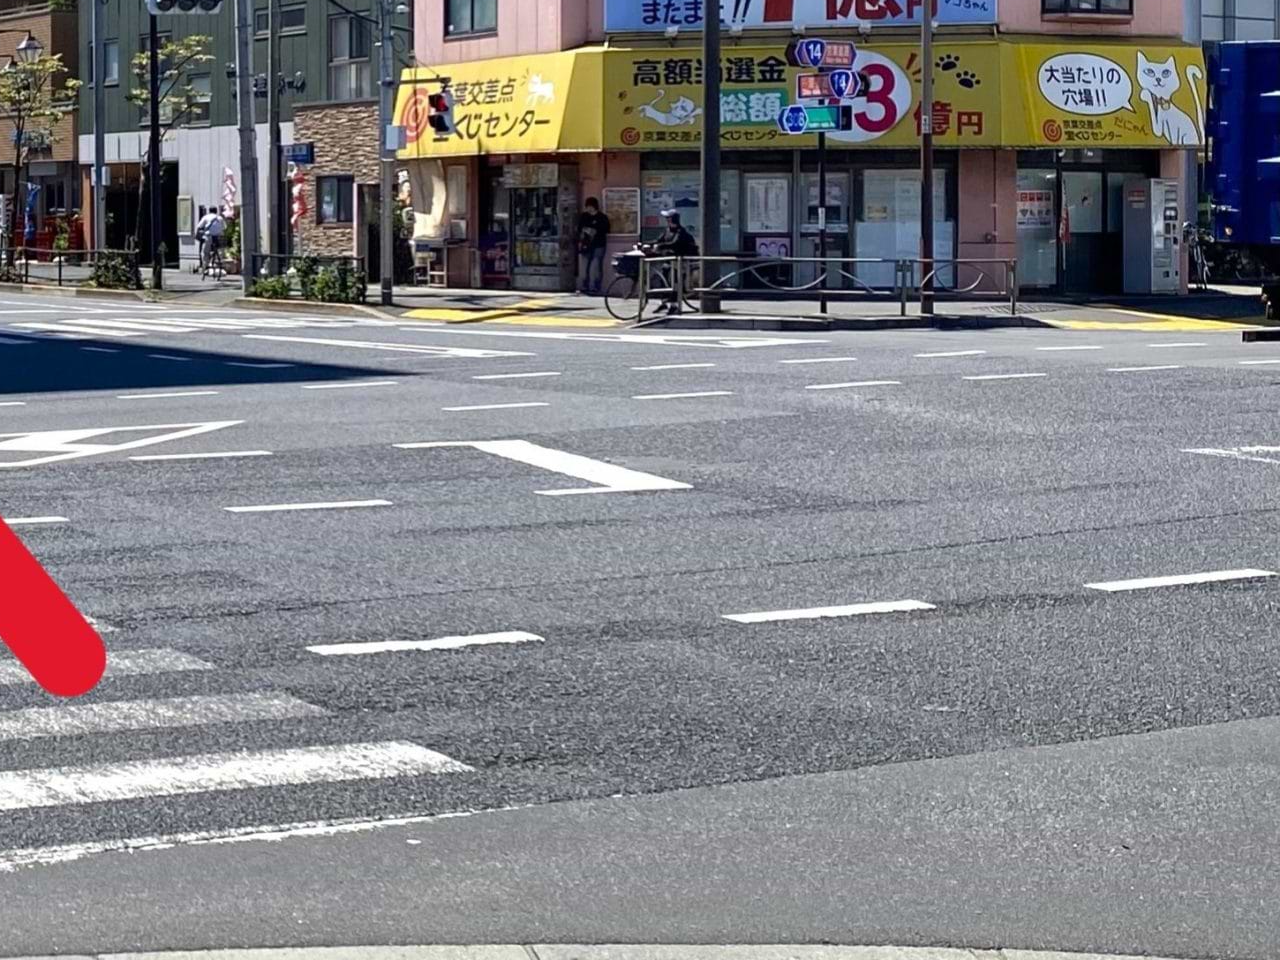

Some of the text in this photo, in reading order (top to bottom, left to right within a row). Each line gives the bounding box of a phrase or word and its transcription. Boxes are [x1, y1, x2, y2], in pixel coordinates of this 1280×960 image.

[808, 43, 822, 60] 14
[834, 74, 847, 90] 14
[1044, 66, 1121, 84] 大当たりの
[441, 76, 516, 107] 葉交差点
[433, 110, 550, 142] くじセンター
[1064, 130, 1122, 141] 宝くじセンター
